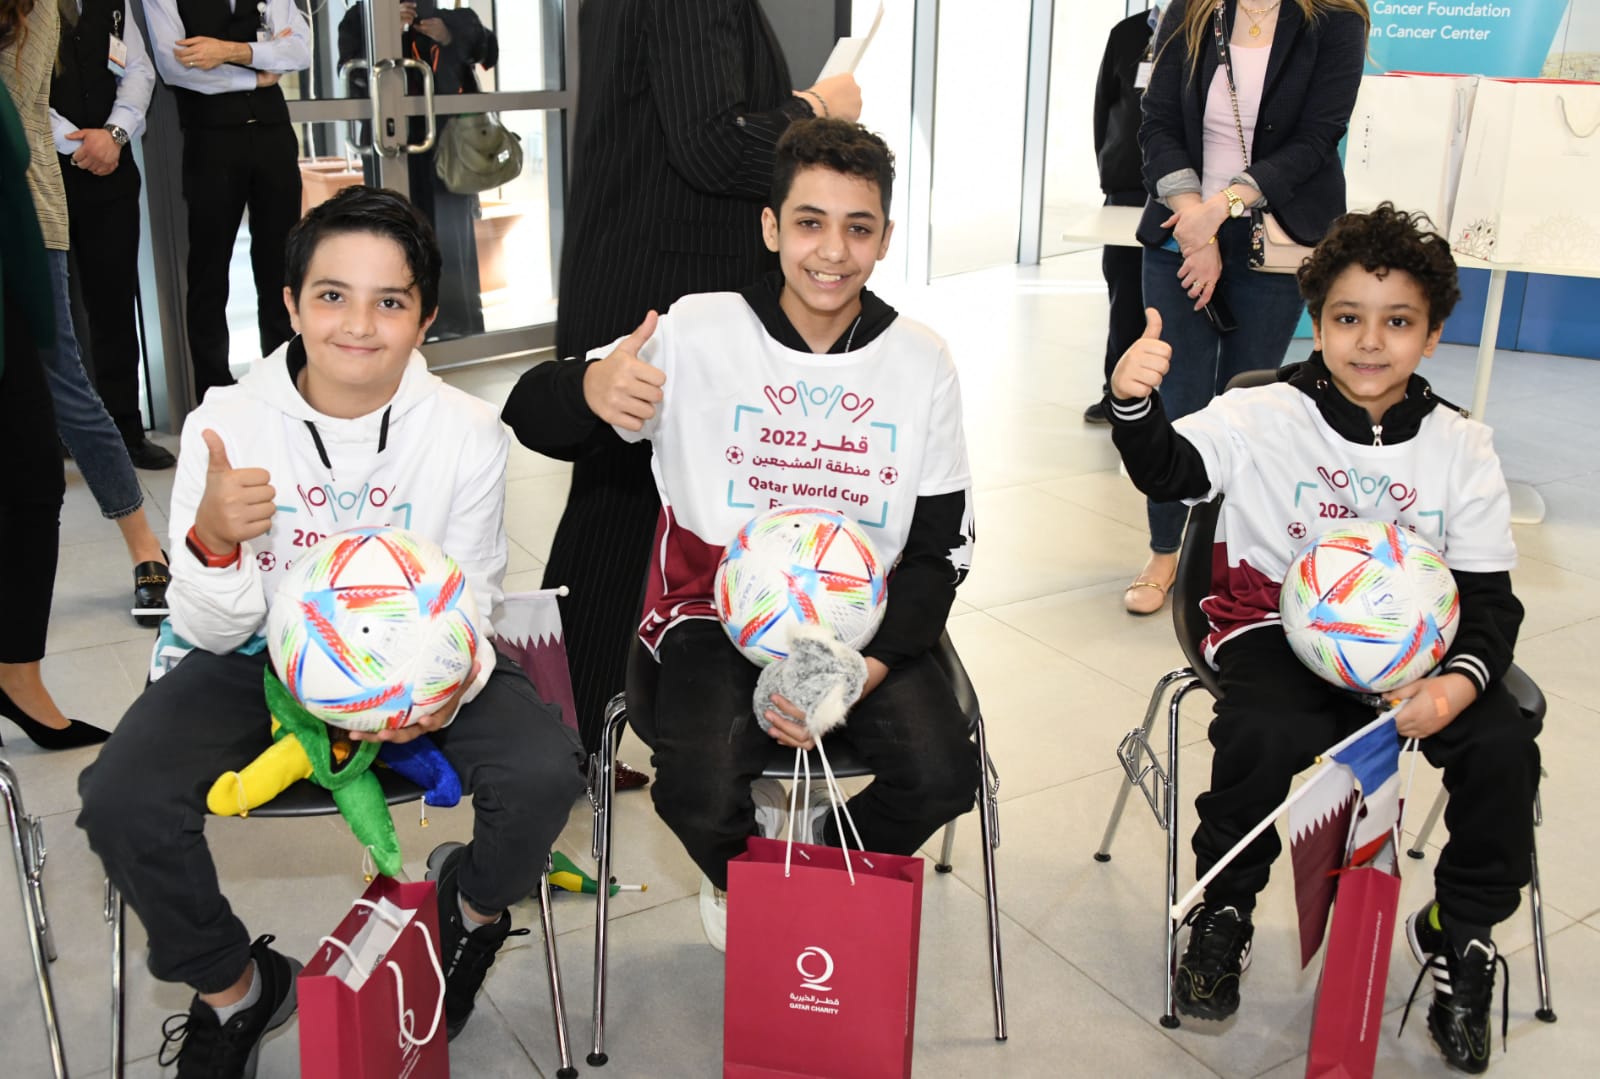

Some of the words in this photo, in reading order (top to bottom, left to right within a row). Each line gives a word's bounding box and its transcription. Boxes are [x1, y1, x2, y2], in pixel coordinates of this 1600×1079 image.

[1373, 1, 1424, 16] Cancer
[1427, 2, 1511, 17] Foundation
[1386, 24, 1436, 39] Cancer
[1440, 25, 1491, 41] Center
[759, 427, 807, 447] 2022
[752, 454, 822, 471] المشجعين
[826, 459, 871, 477] منطقة
[748, 476, 788, 494] Qatar
[792, 483, 838, 499] World
[841, 488, 869, 506] Cup
[292, 529, 327, 548] 20
[789, 1002, 810, 1011] QATAR
[810, 1005, 839, 1015] CHARITY
